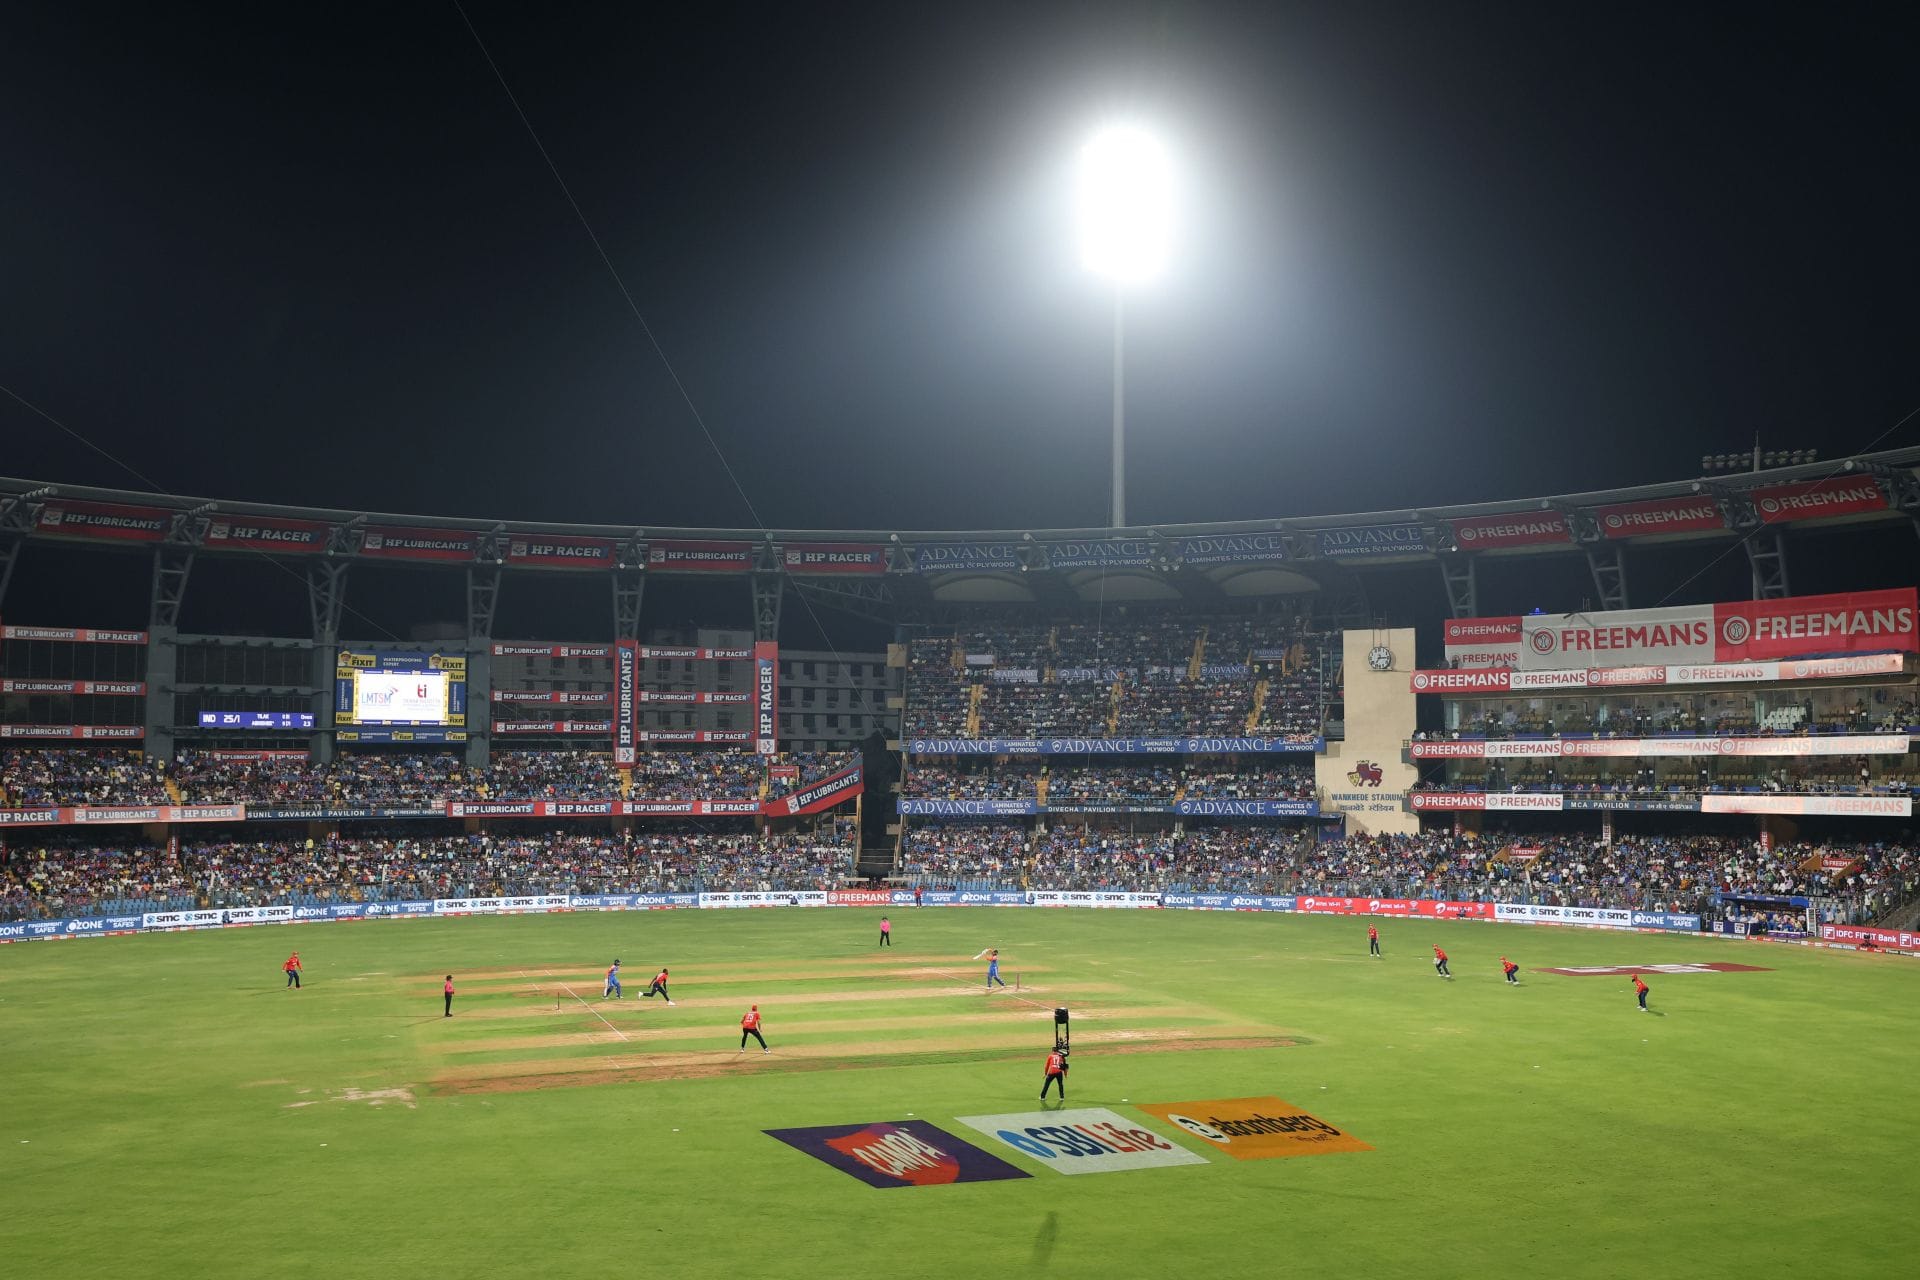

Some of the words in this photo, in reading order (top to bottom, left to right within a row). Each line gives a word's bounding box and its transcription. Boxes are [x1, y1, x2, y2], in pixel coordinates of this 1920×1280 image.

[1782, 486, 1878, 510] FREEMANS
[66, 514, 87, 524] HP
[88, 515, 162, 529] LUBRICANTS
[1624, 507, 1714, 526] FREEMANS
[233, 528, 258, 538] HP
[262, 530, 312, 542] RACER
[1476, 522, 1563, 538] FREEMANS
[1323, 528, 1422, 546] ADVANCE
[386, 538, 404, 547] HP
[404, 540, 469, 550] LUBRICANTS
[1184, 536, 1281, 554] ADVANCE
[1324, 546, 1370, 555] LAMINATES
[1382, 544, 1423, 552] PLYWOOD
[531, 545, 554, 554] HP
[556, 547, 601, 556] RACER
[668, 551, 684, 559] HP
[685, 551, 746, 560] LUBRICANTS
[920, 546, 1014, 560] ADVANCE
[1052, 543, 1146, 558] ADVANCE
[805, 553, 825, 562] HP
[829, 553, 872, 562] RACER
[1186, 555, 1231, 564] LAMINATES
[1242, 553, 1283, 561] PLYWOOD
[920, 562, 965, 570] LAMINATES
[977, 561, 1015, 569] PLYWOOD
[1053, 560, 1098, 568] LAMINATES
[1756, 608, 1913, 640] FREEMANS
[30, 630, 74, 638] LUBRICANTS
[1462, 624, 1516, 636] FREEMANS
[1562, 622, 1708, 651] FREEMANS
[1463, 653, 1517, 663] FREEMANS
[1692, 667, 1763, 679] FREEMANS
[1810, 660, 1886, 675] FREEMANS
[1430, 672, 1507, 687] FREEMANS
[1525, 673, 1586, 684] FREEMANS
[1601, 669, 1664, 681] FREEMANS
[620, 652, 632, 720] LUBRICANTS
[761, 667, 772, 710] RACER
[362, 693, 391, 704] LMTSM
[223, 714, 240, 724] 25/1
[761, 714, 772, 734] HP
[620, 726, 631, 744] HP
[928, 741, 998, 753] ADVANCE
[1065, 741, 1134, 752] ADVANCE
[1201, 740, 1272, 751] ADVANCE
[1425, 745, 1484, 754] FREEMANS
[1500, 744, 1560, 754] FREEMANS
[799, 793, 812, 805] HP
[813, 774, 858, 799] LUBRICANTS
[1426, 796, 1484, 806] FREEMANS
[1500, 796, 1561, 806] FREEMANS
[184, 809, 200, 818] HP
[201, 808, 232, 817] RACER
[466, 805, 480, 814] HP
[480, 804, 532, 814] LUBRICANTS
[558, 805, 575, 814] HP
[576, 804, 606, 813] RACER
[646, 804, 690, 812] LUBRICANTS
[727, 804, 755, 812] RACER
[913, 803, 984, 813] ADVANCE
[1193, 803, 1265, 814] ADVANCE
[14, 812, 52, 822] RACER
[87, 811, 103, 819] HP
[103, 810, 156, 819] LUBRICANTS
[570, 897, 601, 906] OZONE
[636, 896, 666, 905] OZONE
[839, 893, 890, 902] FREEMANS
[960, 893, 991, 903] OZONE
[1164, 894, 1194, 904] OZONE
[1230, 896, 1262, 906] OZONE
[194, 911, 218, 920] smc
[231, 910, 254, 918] smc
[267, 908, 290, 916] smc
[295, 907, 327, 919] OZONE
[1505, 906, 1526, 915] smc
[156, 914, 180, 923] smc
[1632, 912, 1664, 924] OZONE
[66, 920, 103, 932] OZONE
[1836, 930, 1854, 939] IDFC
[1878, 934, 1897, 943] Bank
[852, 1128, 946, 1176] CAMPA
